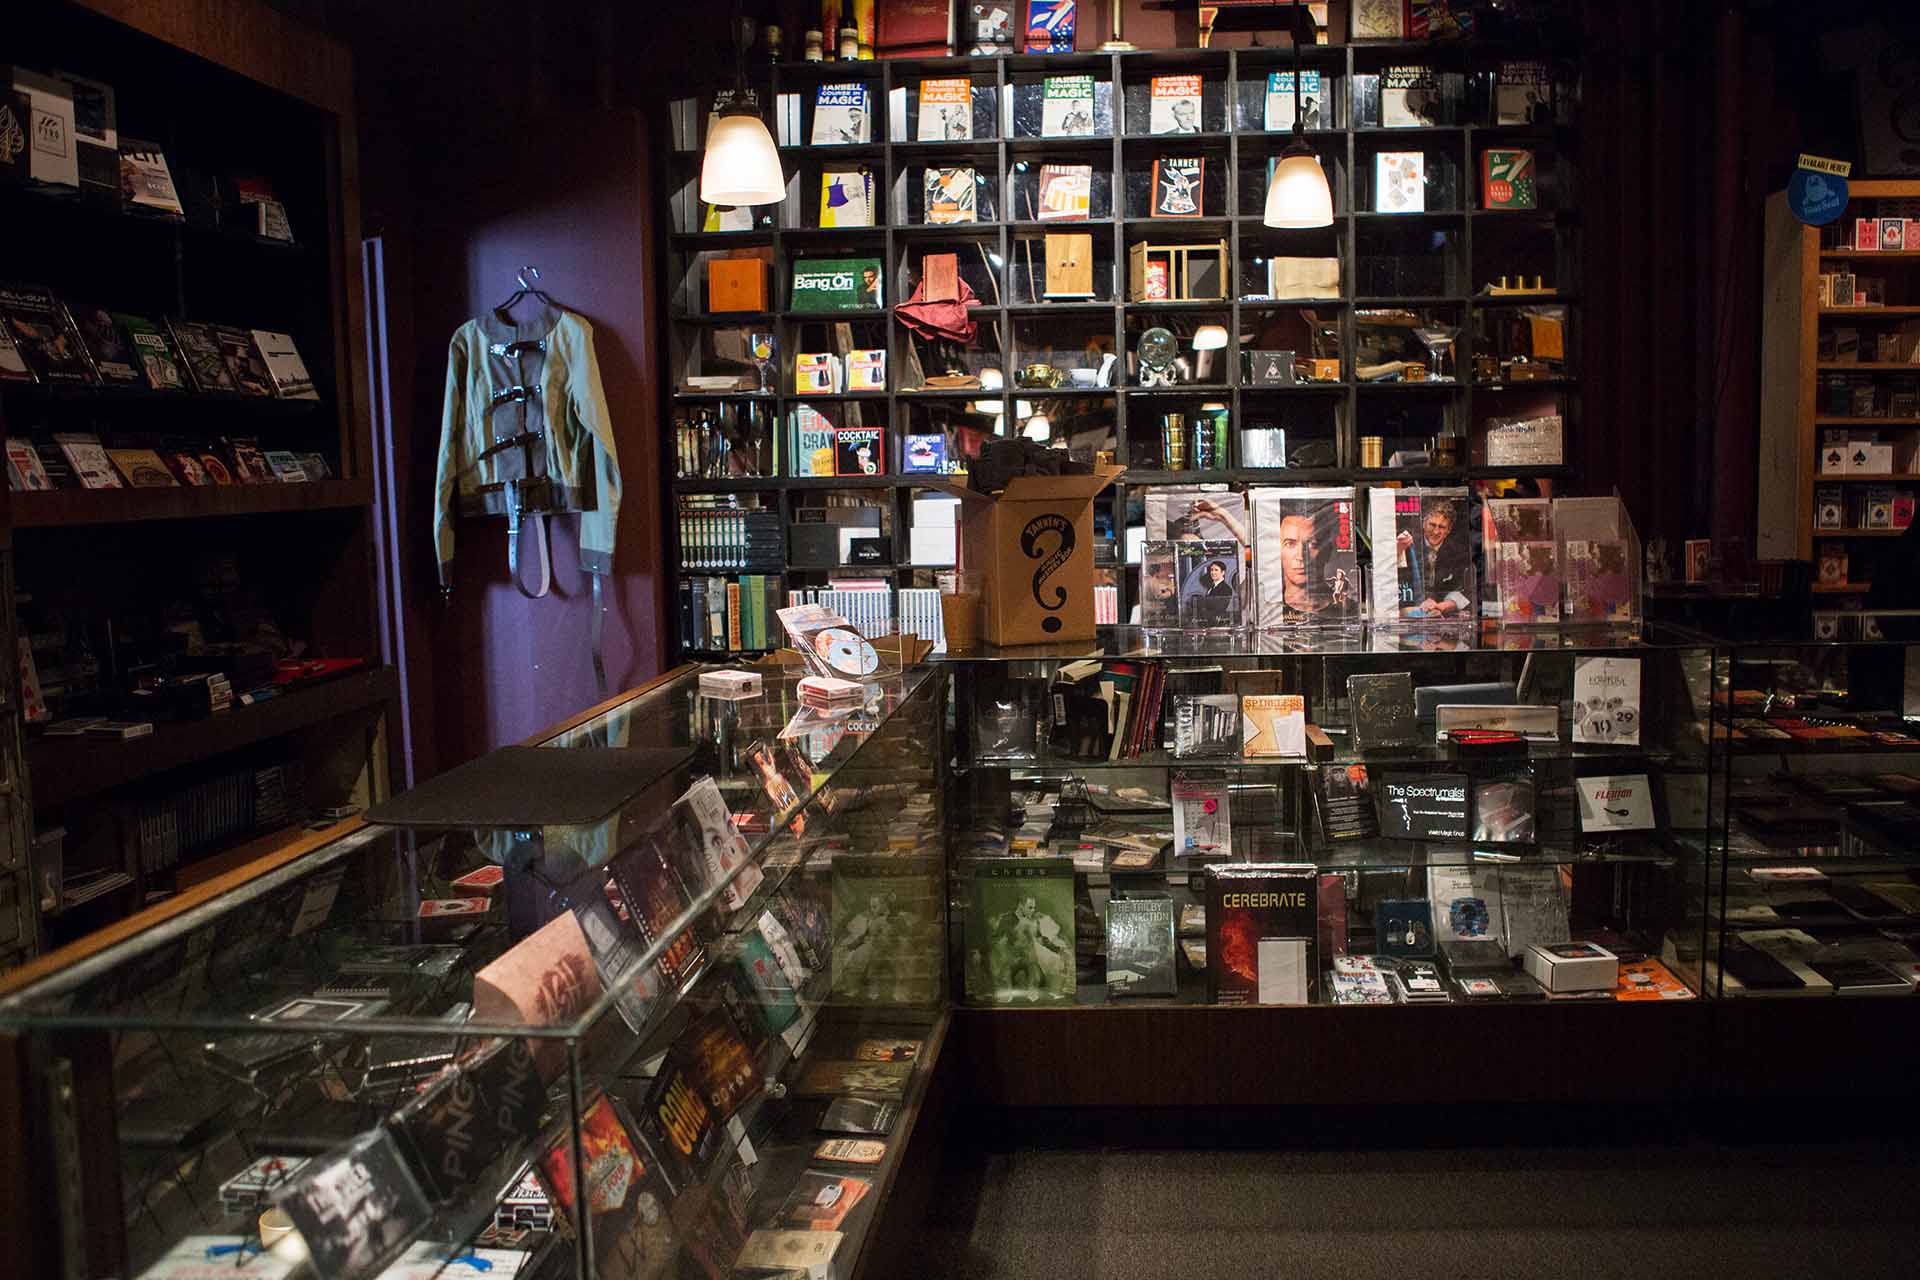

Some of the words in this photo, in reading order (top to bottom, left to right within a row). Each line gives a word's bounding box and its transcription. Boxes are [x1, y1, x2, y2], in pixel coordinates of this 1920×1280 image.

[1273, 83, 1319, 92] MAIC
[1387, 79, 1433, 88] MAGIC
[1047, 89, 1092, 98] MAGIC
[1155, 88, 1200, 96] MAGIC
[818, 96, 862, 105] MAGIC
[922, 93, 967, 102] MAGIC
[795, 277, 830, 291] Bang
[832, 275, 854, 289] On
[838, 431, 879, 440] COCKTAIL
[1616, 711, 1634, 722] 29
[1387, 785, 1405, 796] The
[1223, 892, 1306, 908] CEREBRATE
